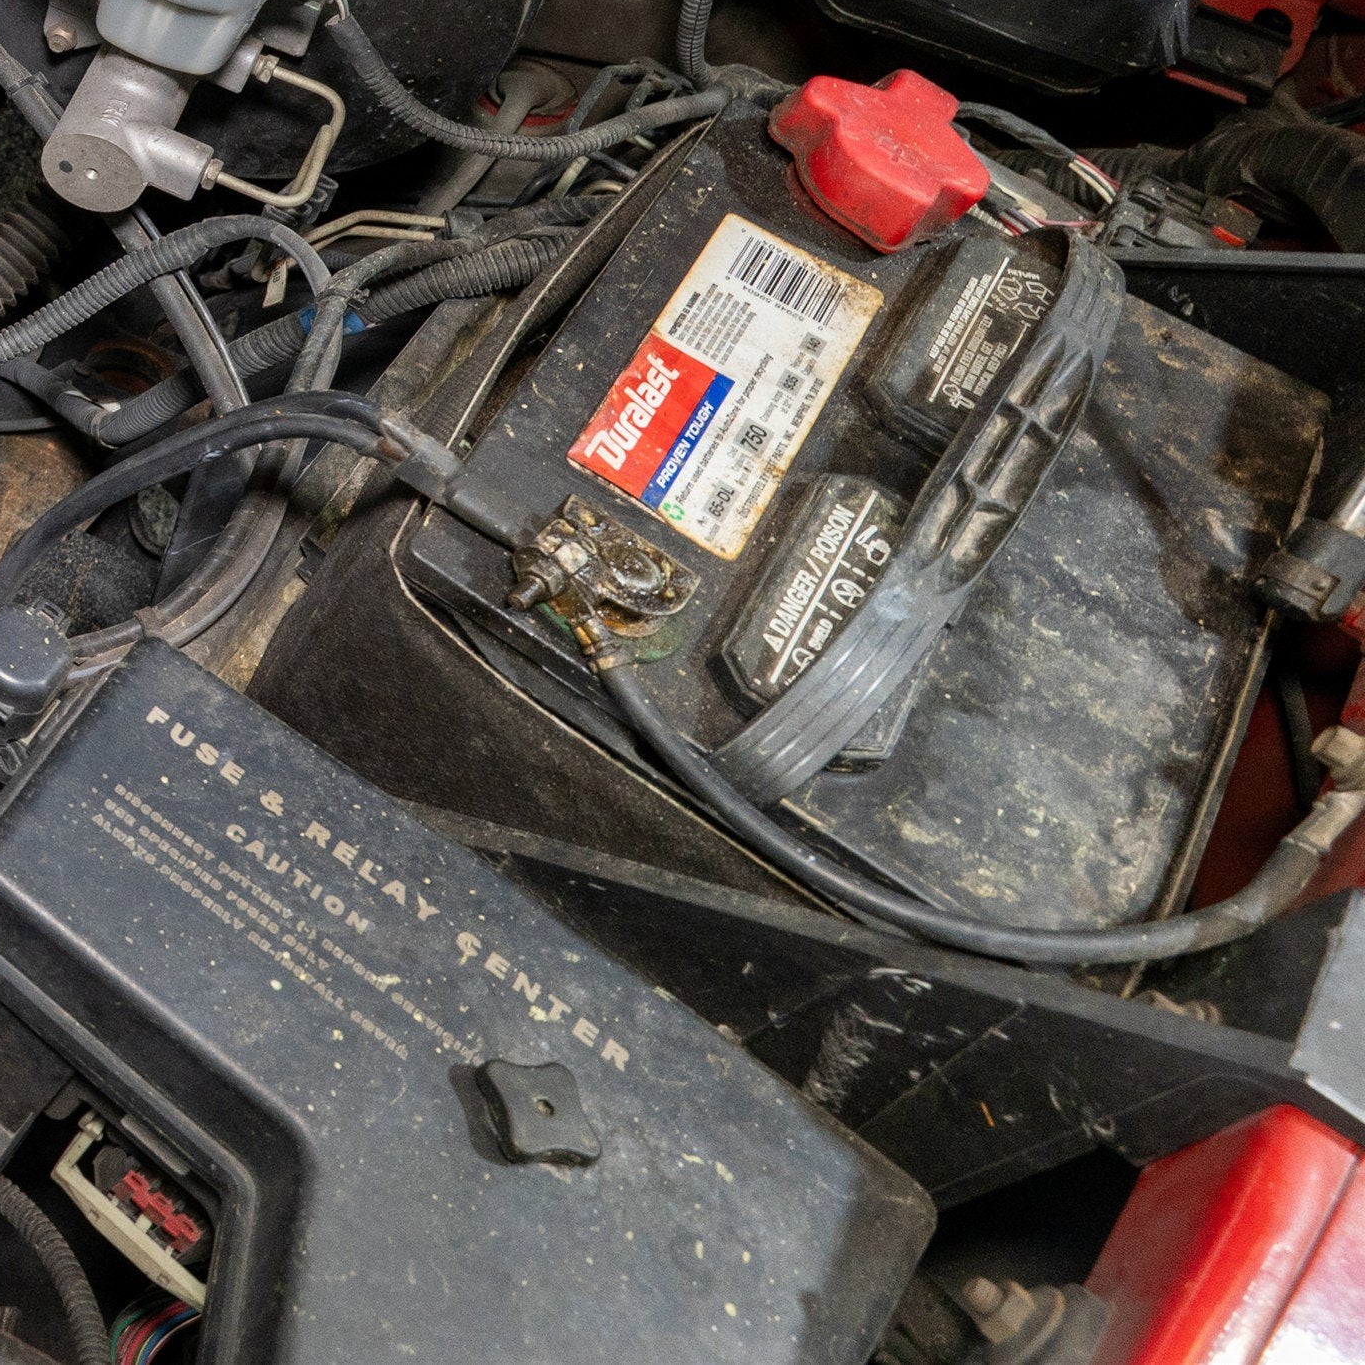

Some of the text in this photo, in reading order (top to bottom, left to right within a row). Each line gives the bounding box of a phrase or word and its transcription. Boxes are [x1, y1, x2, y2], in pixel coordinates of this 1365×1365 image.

[780, 372, 799, 392] 935
[804, 334, 822, 354] 140
[584, 355, 680, 471] Duralast
[654, 437, 693, 491] PROVEN
[682, 400, 714, 442] TOUGH
[673, 350, 774, 506] Return used batteries to AutoZone for proper recycling
[739, 421, 769, 454] 750
[706, 482, 736, 519] 65-DL
[767, 502, 856, 638] DANGER / POISON
[806, 616, 835, 652] SHIELD
[90, 810, 159, 867] ALWAYS
[157, 861, 246, 934] PROPERLY
[101, 797, 333, 973] USE SPECIFIED FUSES ONLY
[111, 782, 217, 864] DISCONNECT
[216, 858, 297, 922] BATTERY
[319, 933, 393, 992] BEFORE
[142, 703, 635, 1073] FUSE & RELAY CENTER
[221, 820, 374, 938] CAUTION
